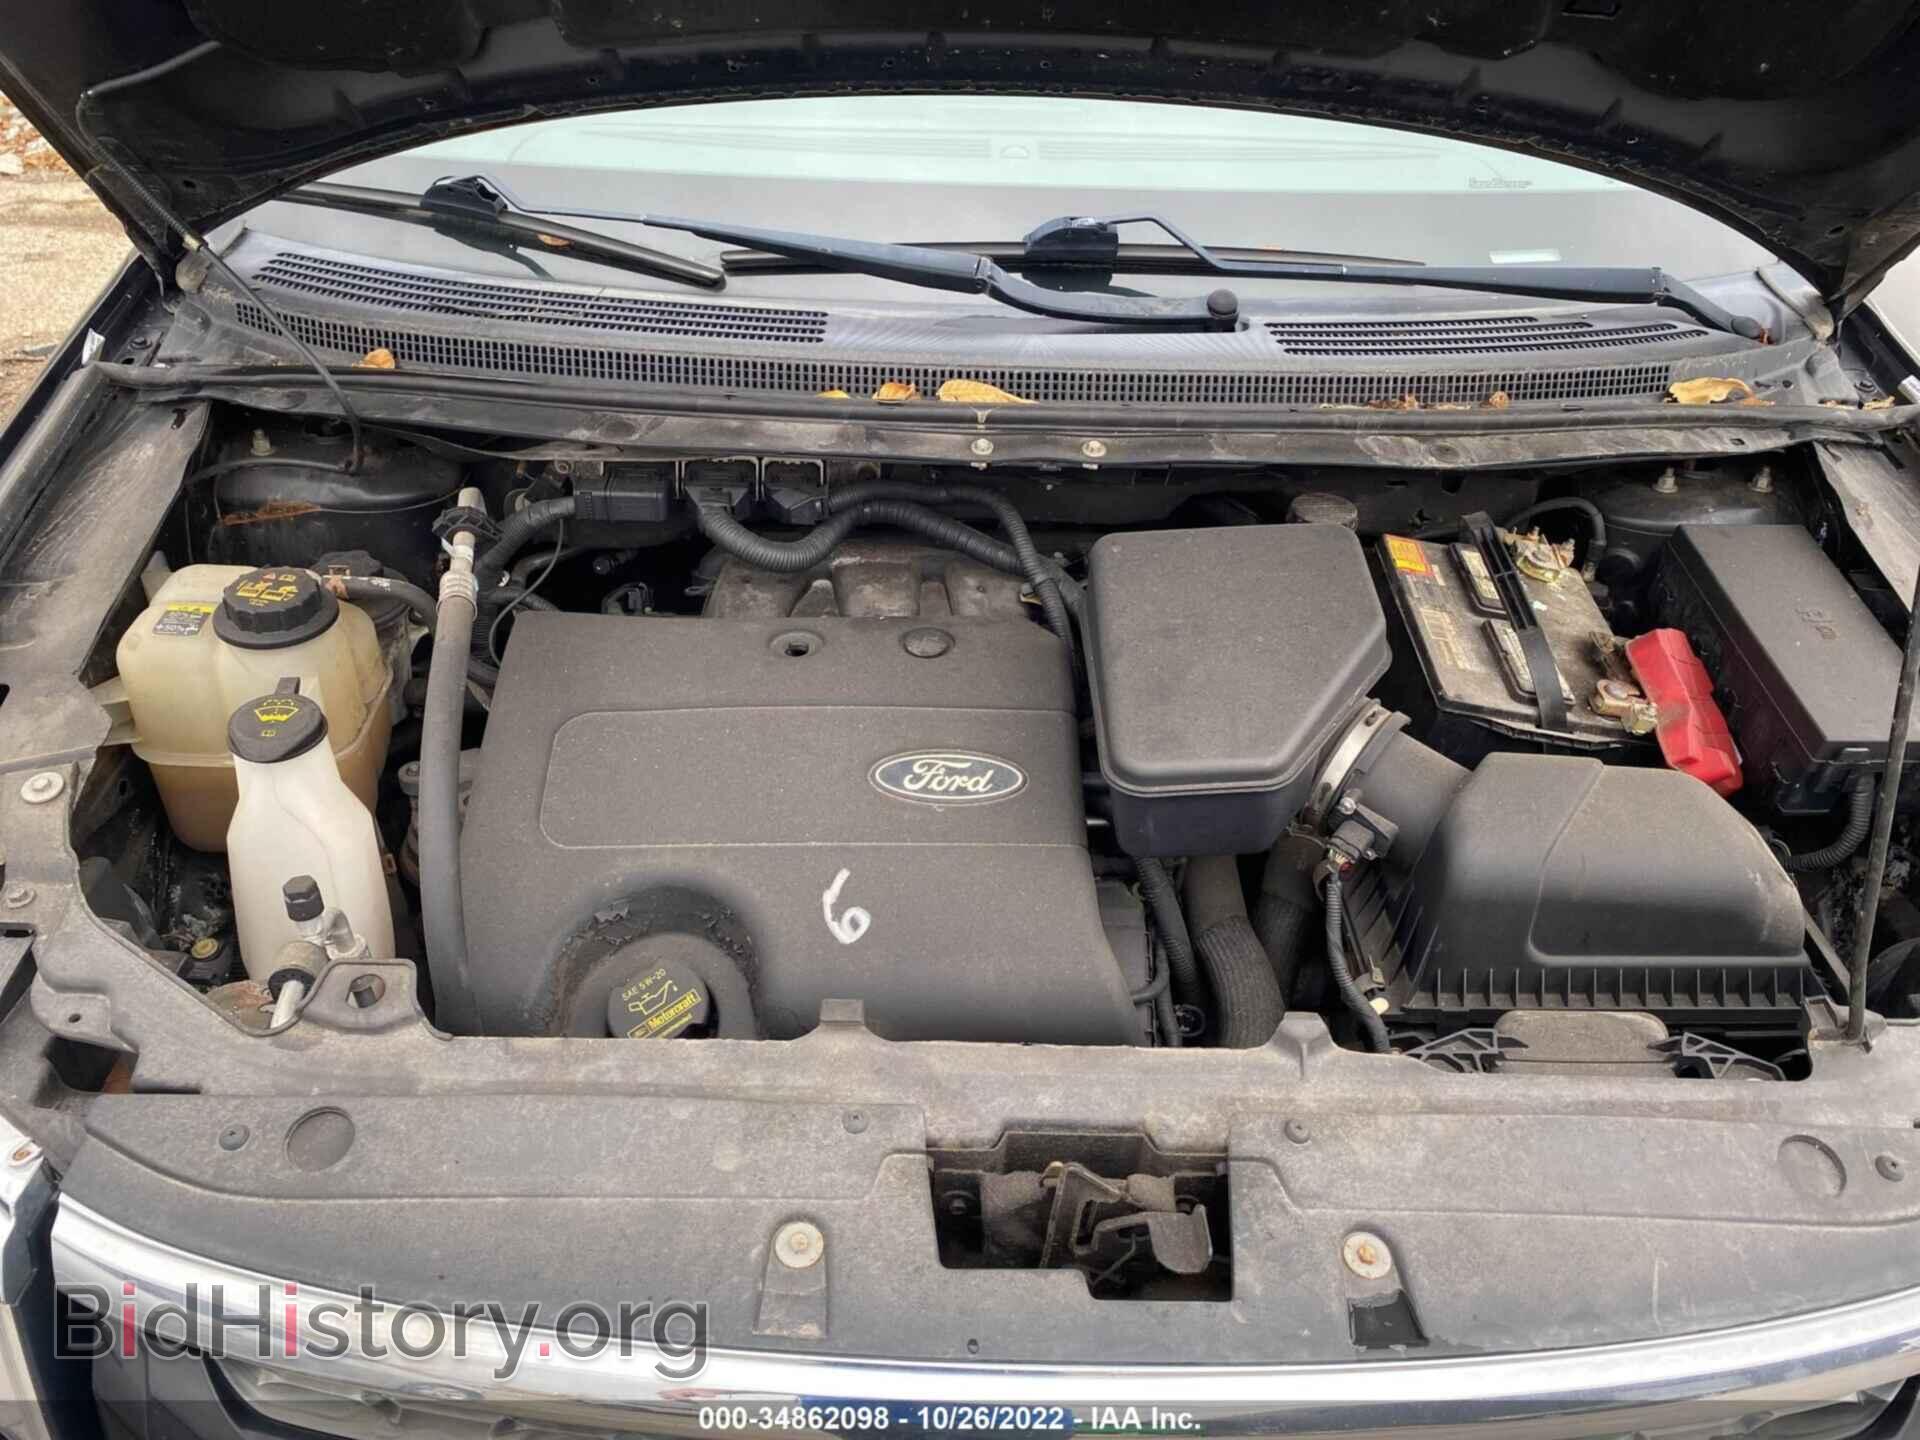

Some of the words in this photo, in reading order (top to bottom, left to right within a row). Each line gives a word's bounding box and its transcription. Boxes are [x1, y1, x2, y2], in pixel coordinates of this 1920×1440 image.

[903, 759, 994, 792] Ford
[822, 868, 872, 945] 6
[647, 993, 697, 1028] Motorcraft
